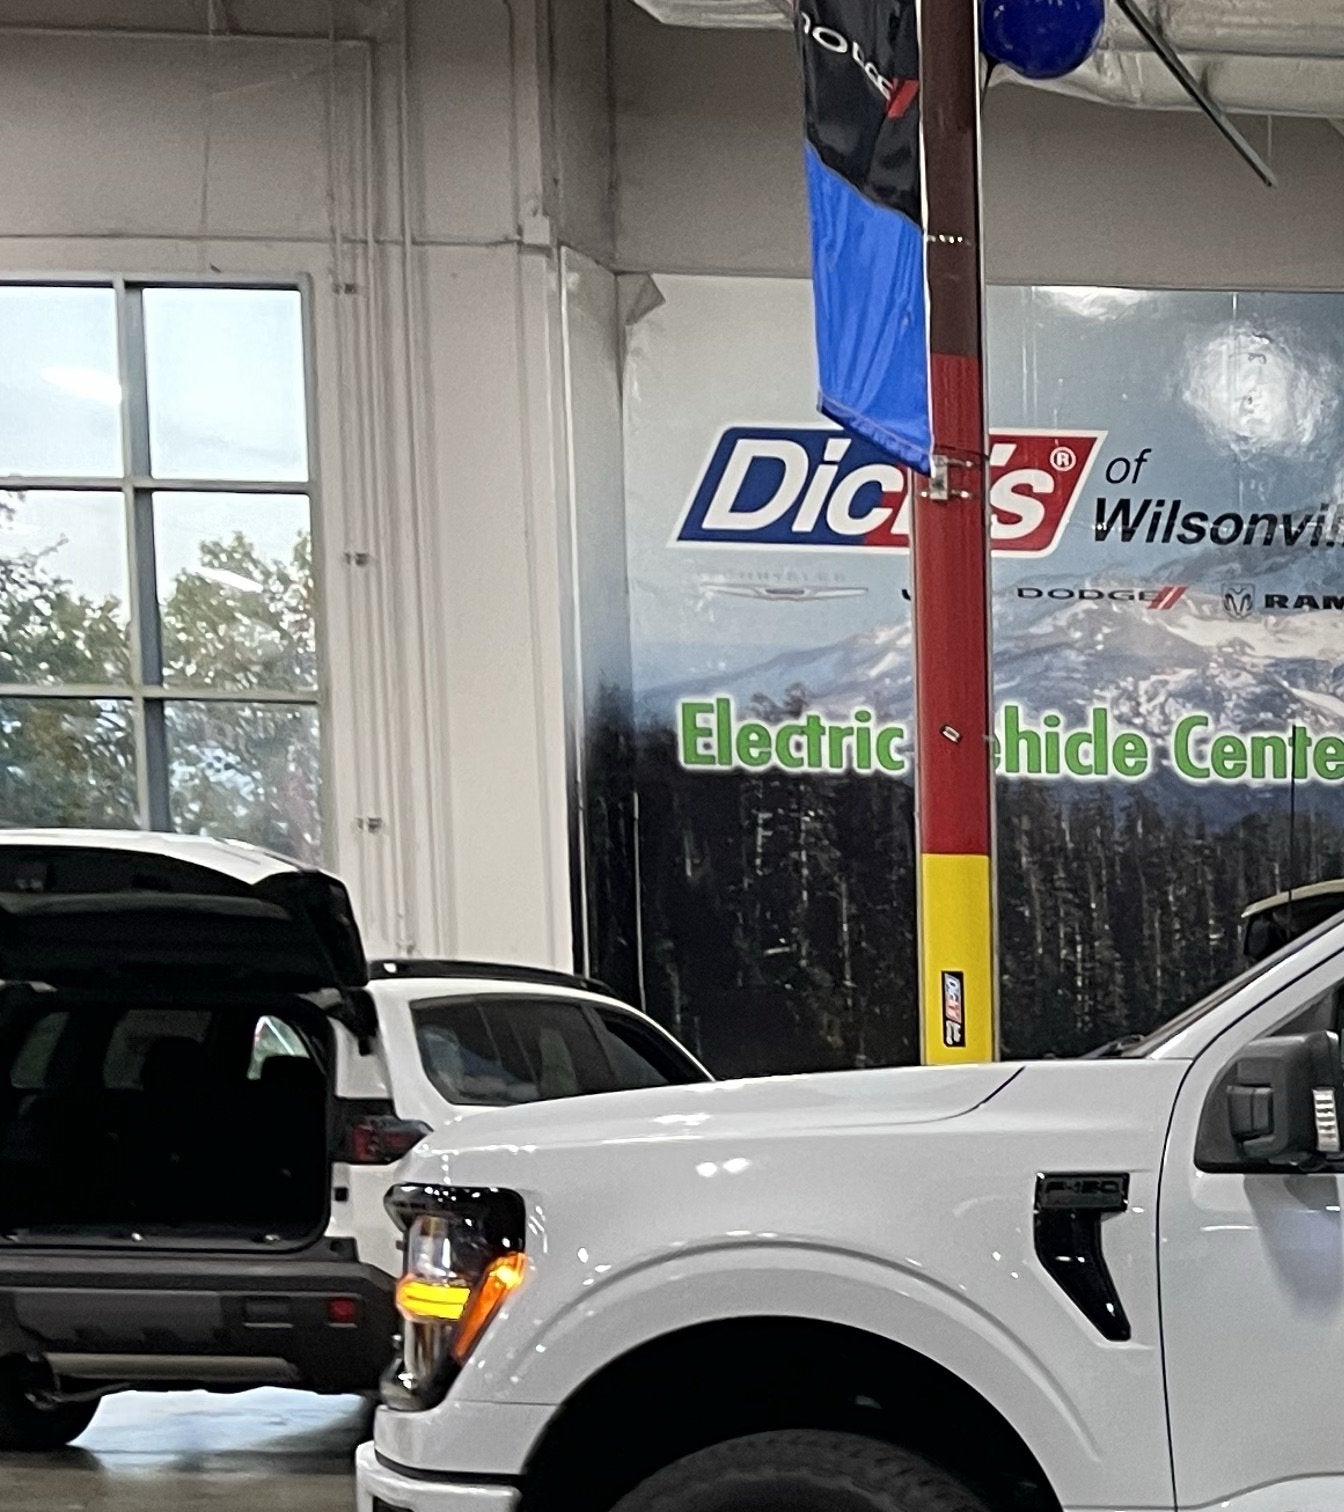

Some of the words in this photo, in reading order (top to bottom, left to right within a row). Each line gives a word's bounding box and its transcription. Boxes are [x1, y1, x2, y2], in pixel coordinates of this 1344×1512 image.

[1105, 448, 1152, 485] of
[1016, 587, 1160, 602] DODGE
[681, 697, 905, 772] Electric
[992, 704, 1149, 778] hicle
